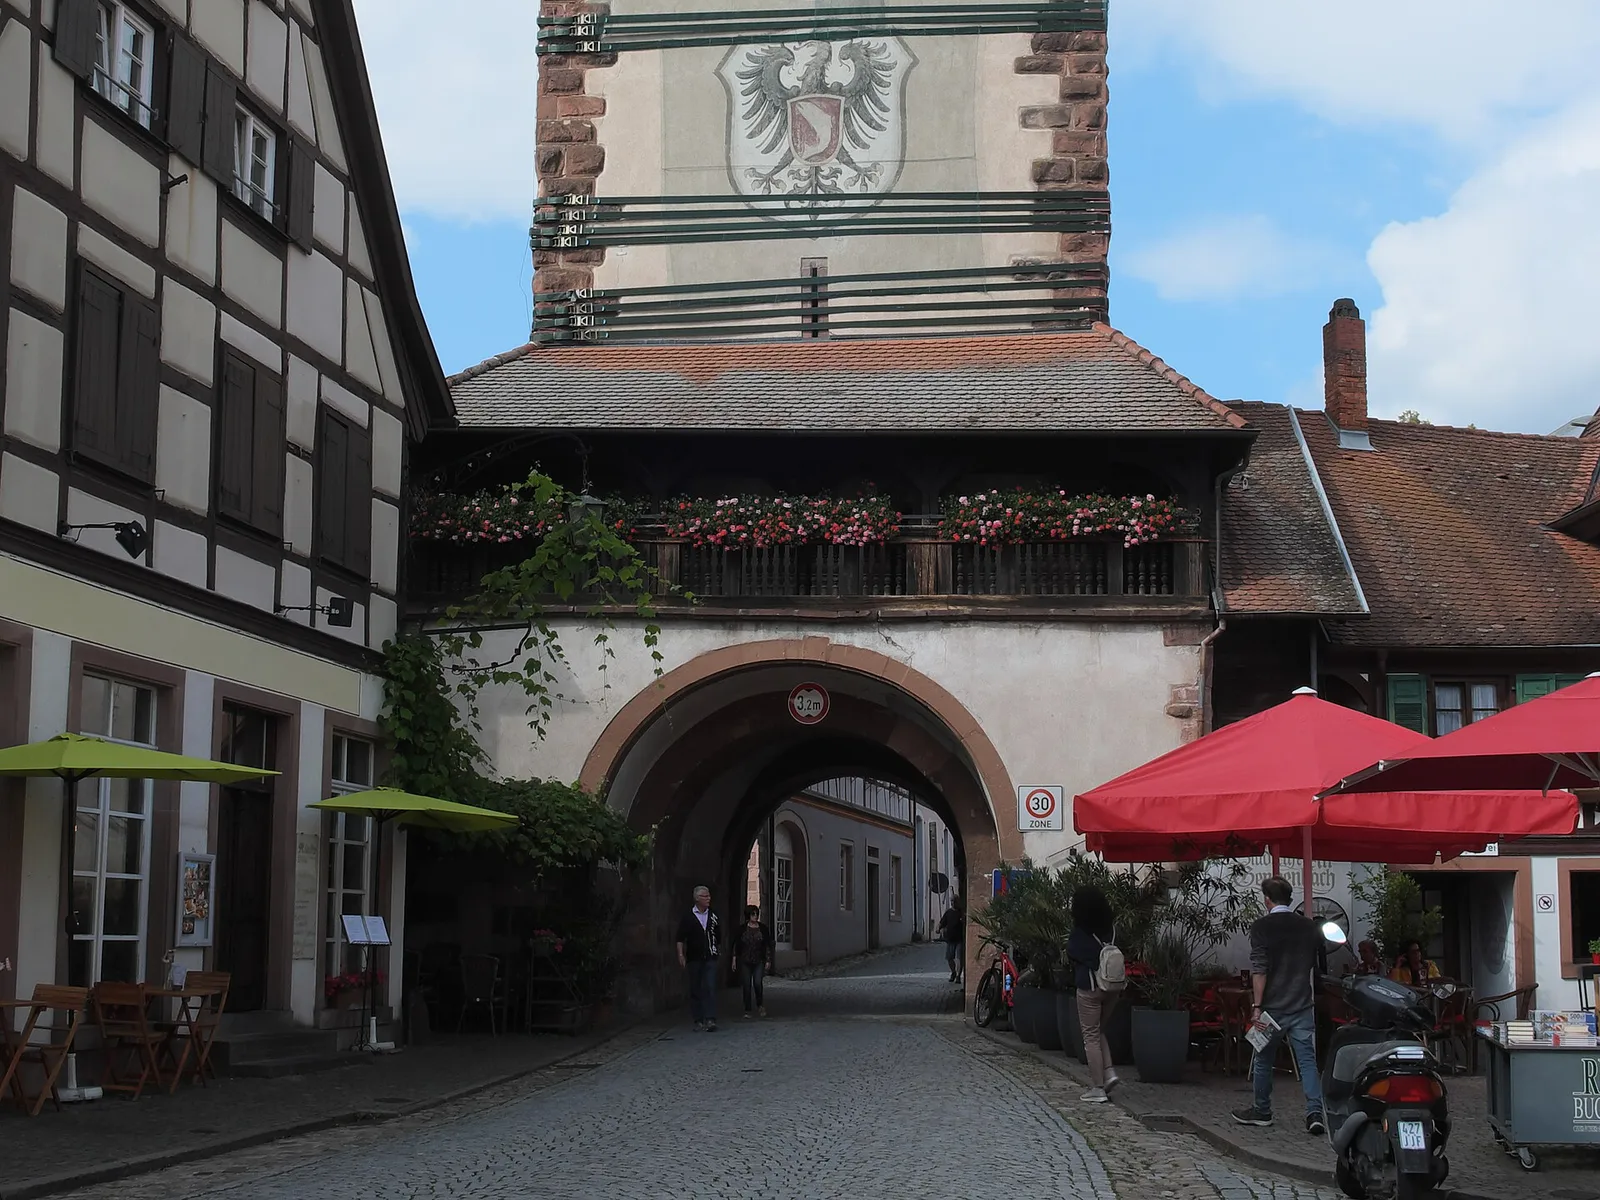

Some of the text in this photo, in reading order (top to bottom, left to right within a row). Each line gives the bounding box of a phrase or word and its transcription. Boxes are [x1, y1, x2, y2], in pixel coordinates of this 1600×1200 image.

[1032, 797, 1049, 811] 30
[1029, 820, 1052, 828] ZONE
[1581, 1058, 1600, 1095] R
[1402, 1123, 1420, 1134] 427
[1405, 1135, 1421, 1147] JJF
